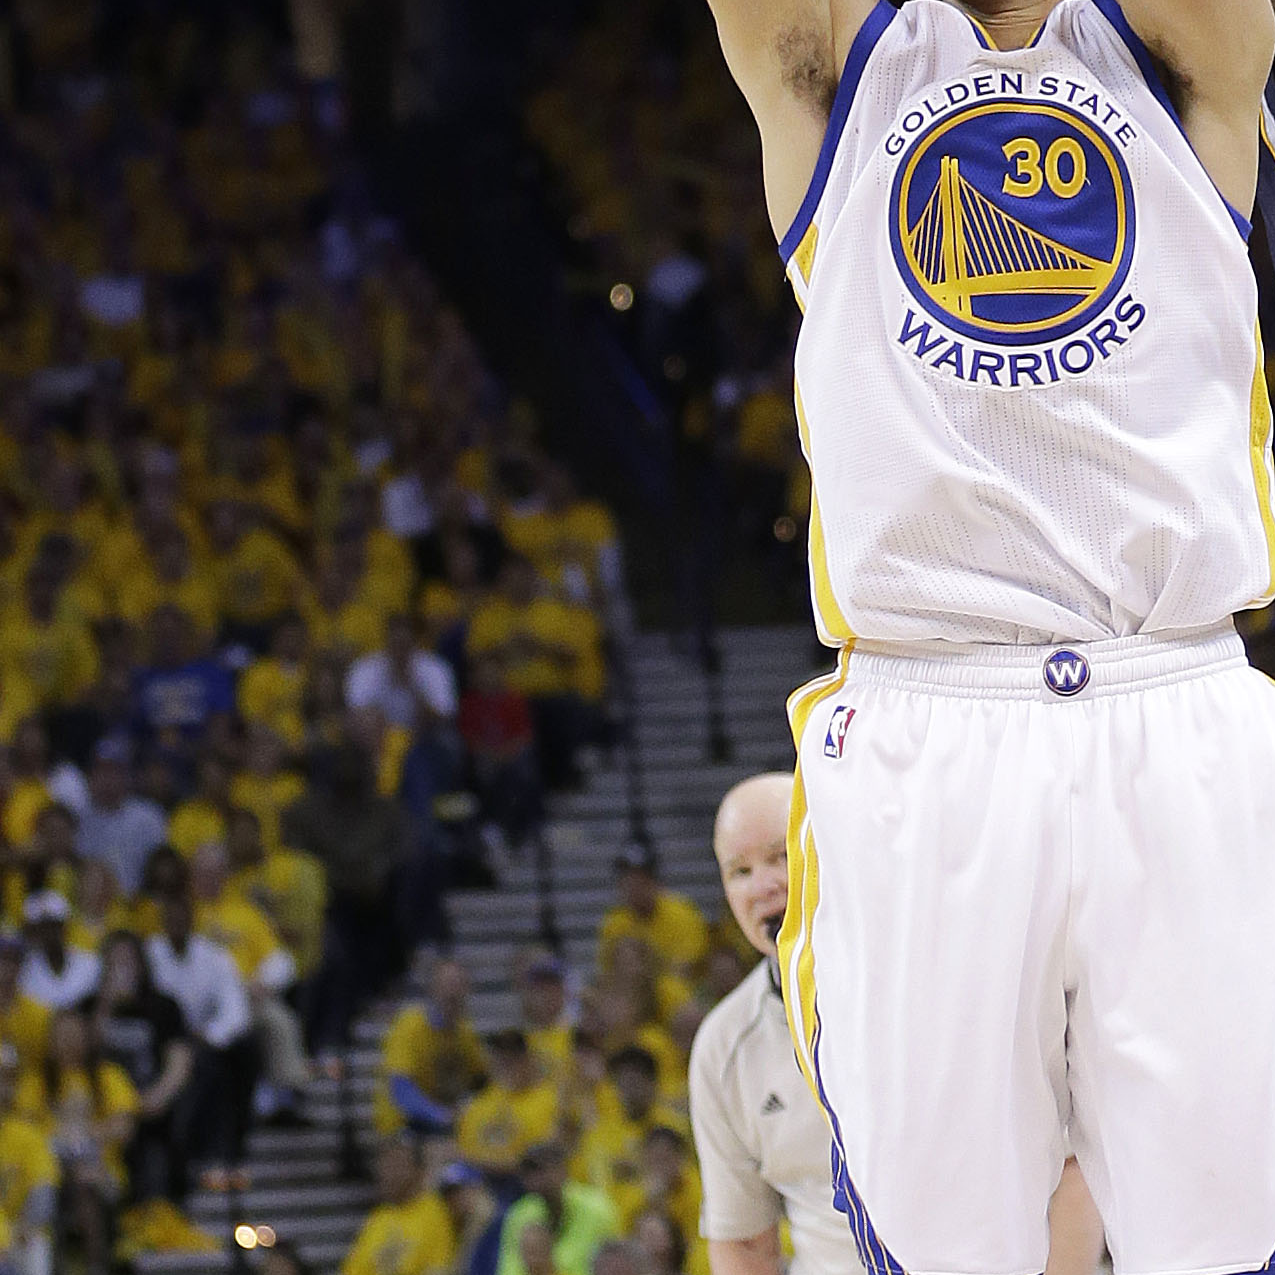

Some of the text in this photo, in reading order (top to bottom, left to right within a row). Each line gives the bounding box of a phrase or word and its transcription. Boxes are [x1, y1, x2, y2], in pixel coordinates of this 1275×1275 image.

[885, 72, 1138, 158] GOLDEN STATE
[1002, 136, 1088, 199] 30
[898, 294, 1146, 388] WARRIORS
[1048, 659, 1083, 686] W
